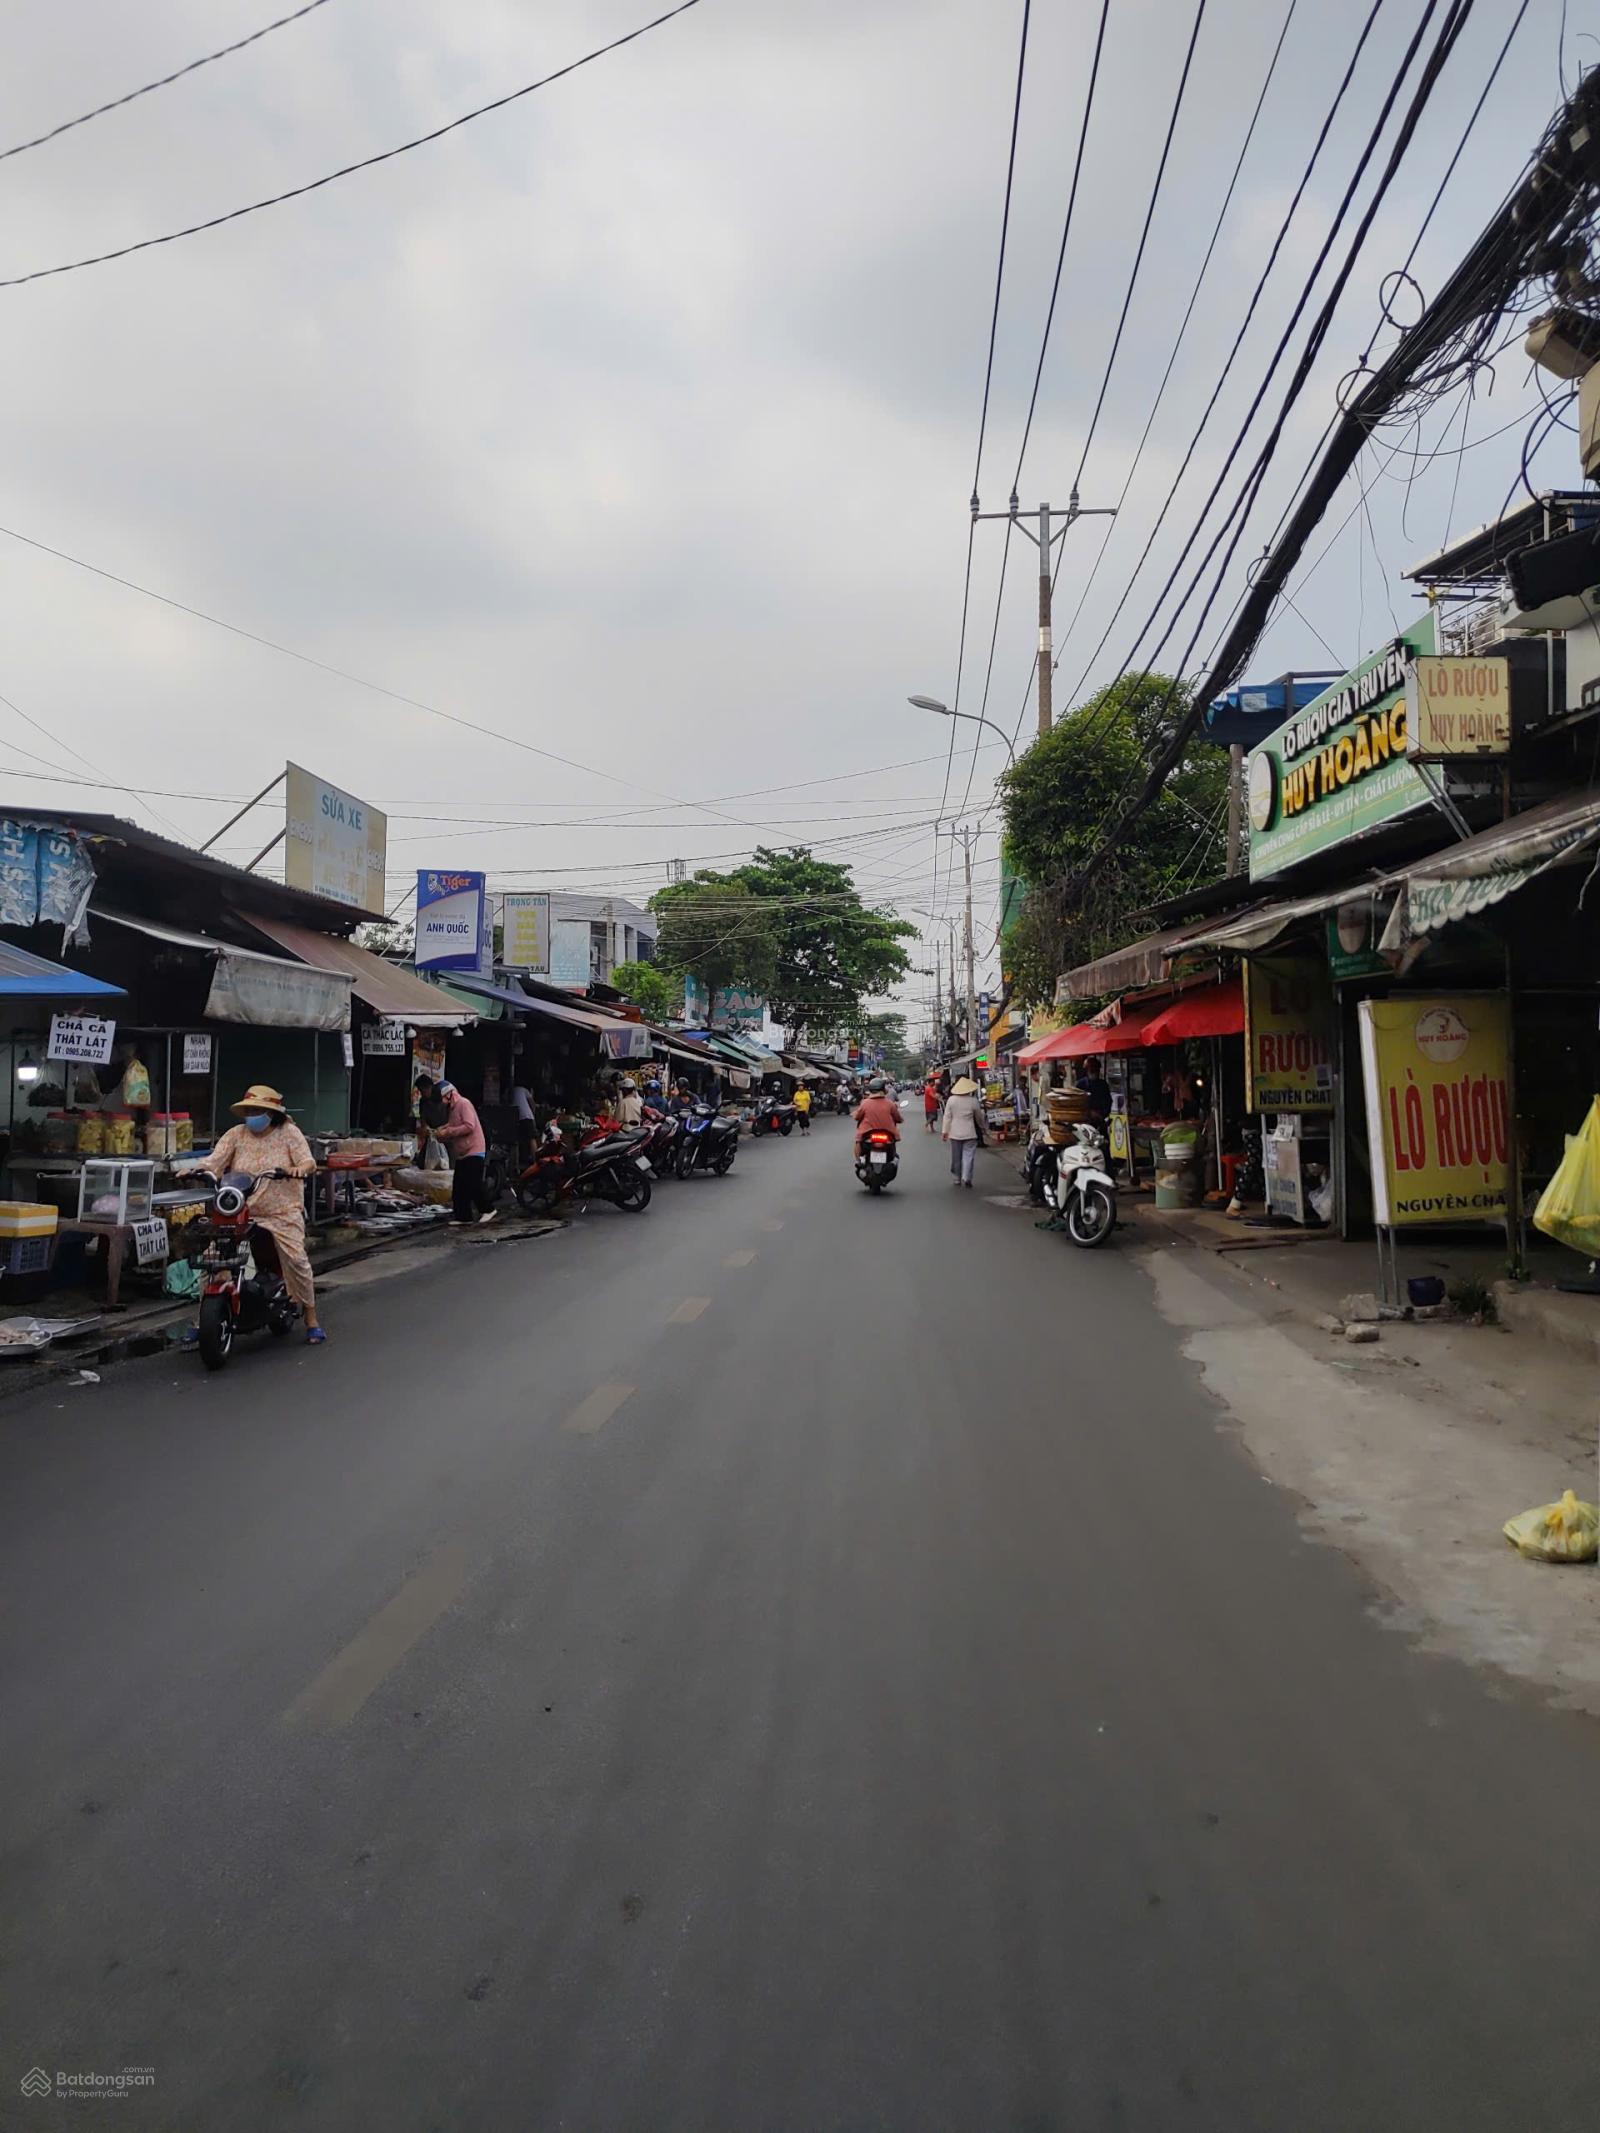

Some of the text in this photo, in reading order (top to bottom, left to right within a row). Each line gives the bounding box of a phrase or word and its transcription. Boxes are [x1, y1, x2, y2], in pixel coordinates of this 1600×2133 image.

[1428, 663, 1499, 702] LÒ RƯỢU
[1327, 688, 1352, 726] GIA
[1430, 707, 1504, 742] HUY HOÀNG
[1281, 698, 1407, 817] HUY HOÀNG
[321, 790, 362, 831] SỬA XE
[439, 874, 472, 891] Tiger
[427, 921, 470, 934] ANH QUỐC
[57, 1020, 83, 1031] CHẢ
[1389, 1068, 1509, 1183] LÒ RƯỢU
[1397, 1194, 1468, 1213] NGUYÊN
